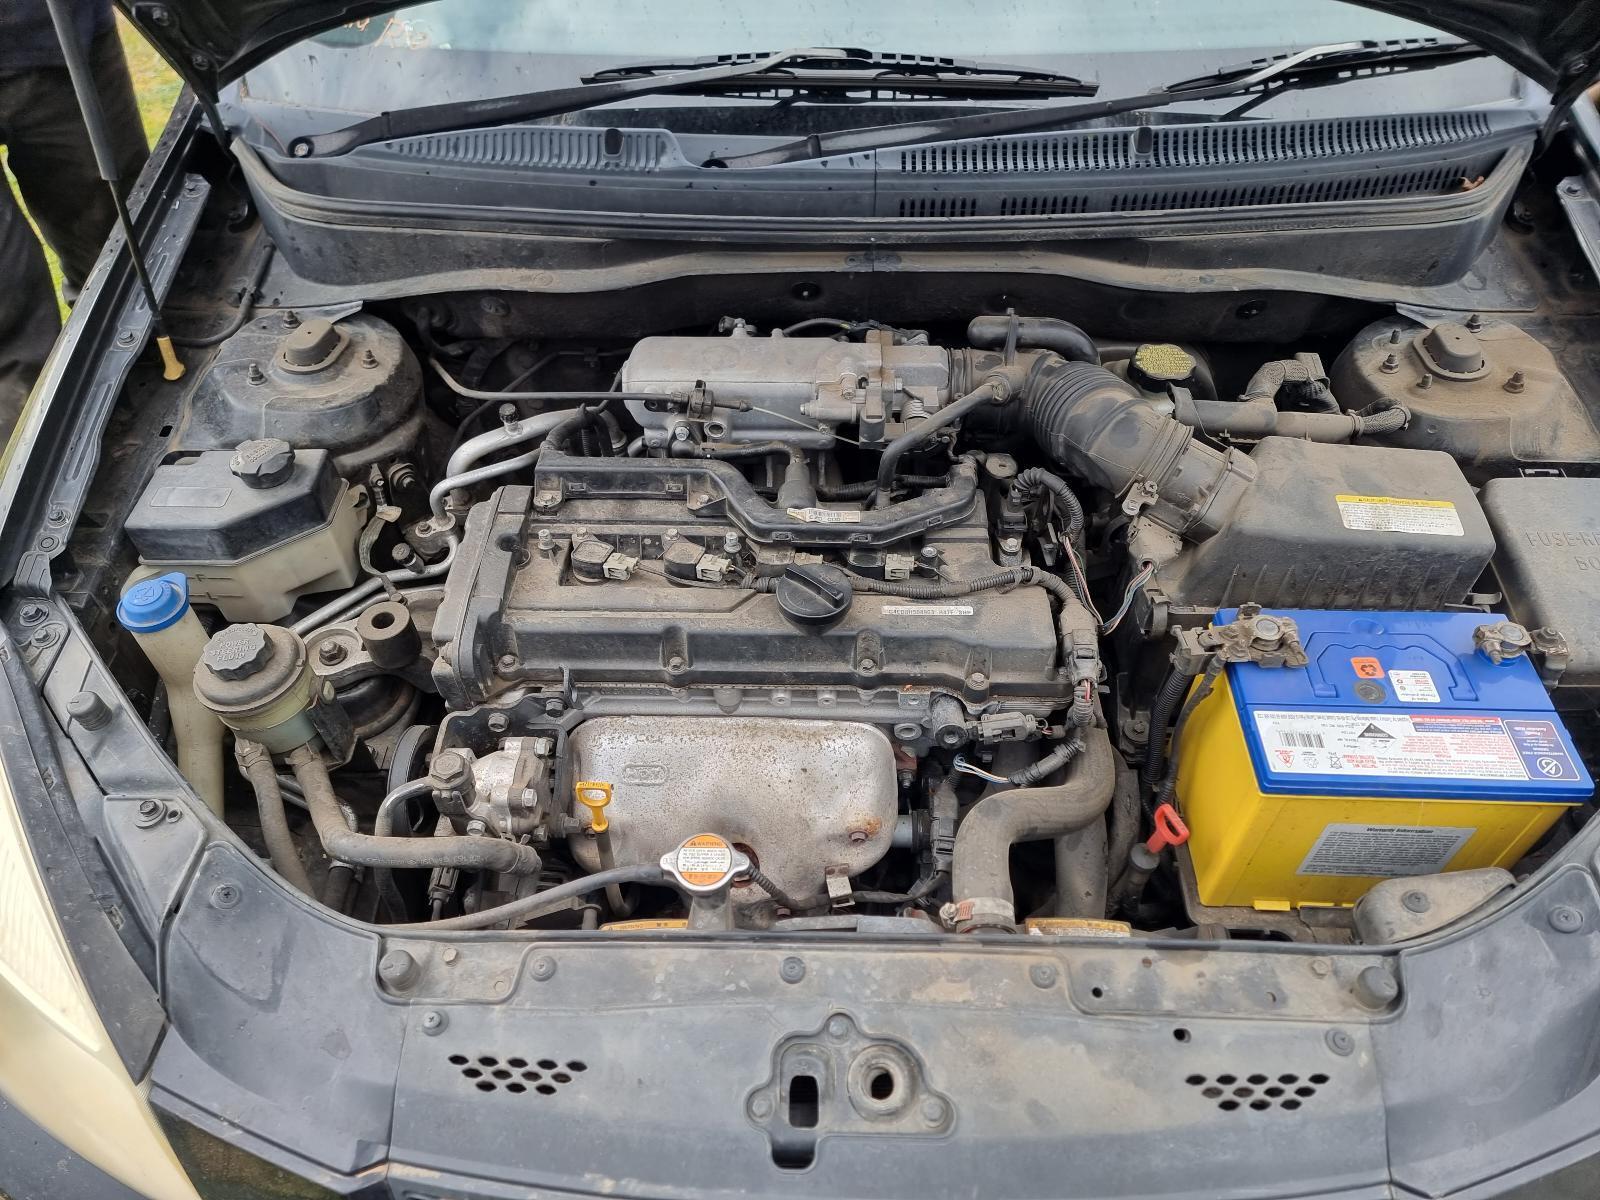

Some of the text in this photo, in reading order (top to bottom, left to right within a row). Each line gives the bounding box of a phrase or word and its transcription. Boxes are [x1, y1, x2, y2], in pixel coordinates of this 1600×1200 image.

[219, 639, 250, 649] POWER
[209, 644, 257, 658] STEERING
[216, 652, 245, 662] FLUID
